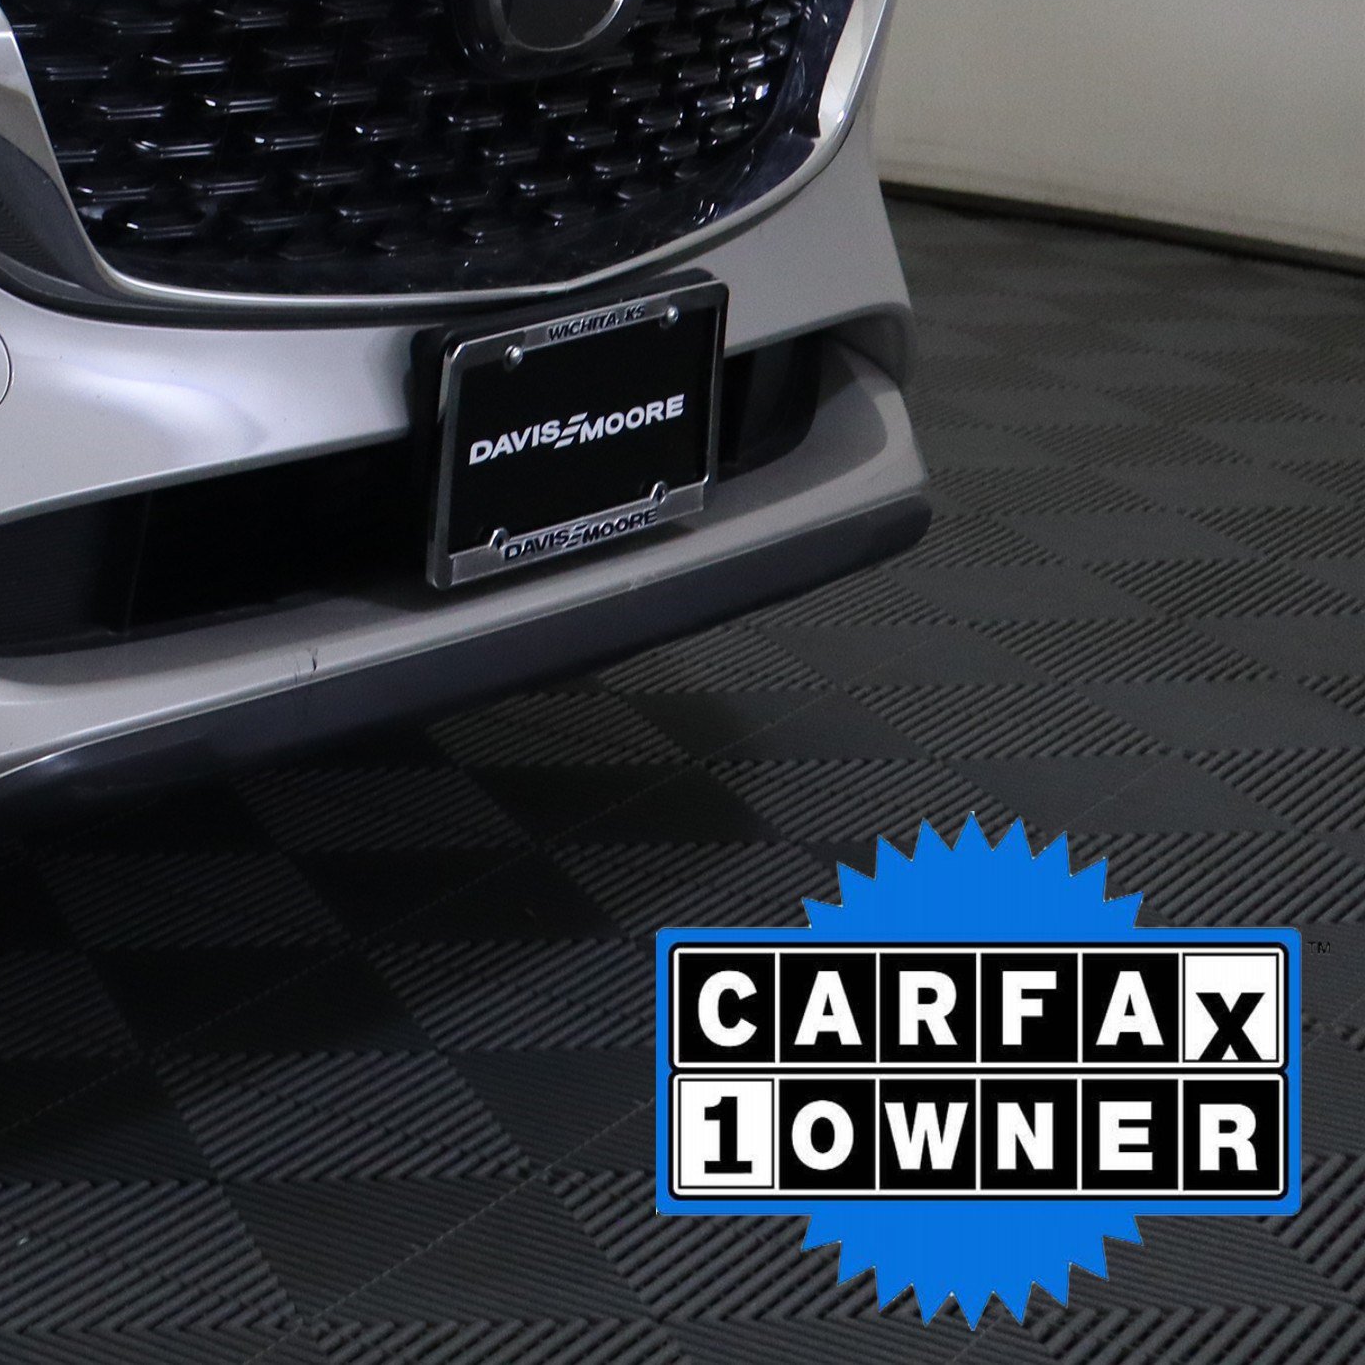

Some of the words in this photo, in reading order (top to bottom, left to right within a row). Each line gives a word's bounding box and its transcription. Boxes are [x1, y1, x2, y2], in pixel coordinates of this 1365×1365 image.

[624, 305, 646, 322] KS
[469, 420, 562, 465] DAVIS
[580, 394, 685, 444] MOORE
[504, 530, 571, 561] DAVIS
[582, 508, 658, 544] MOORE
